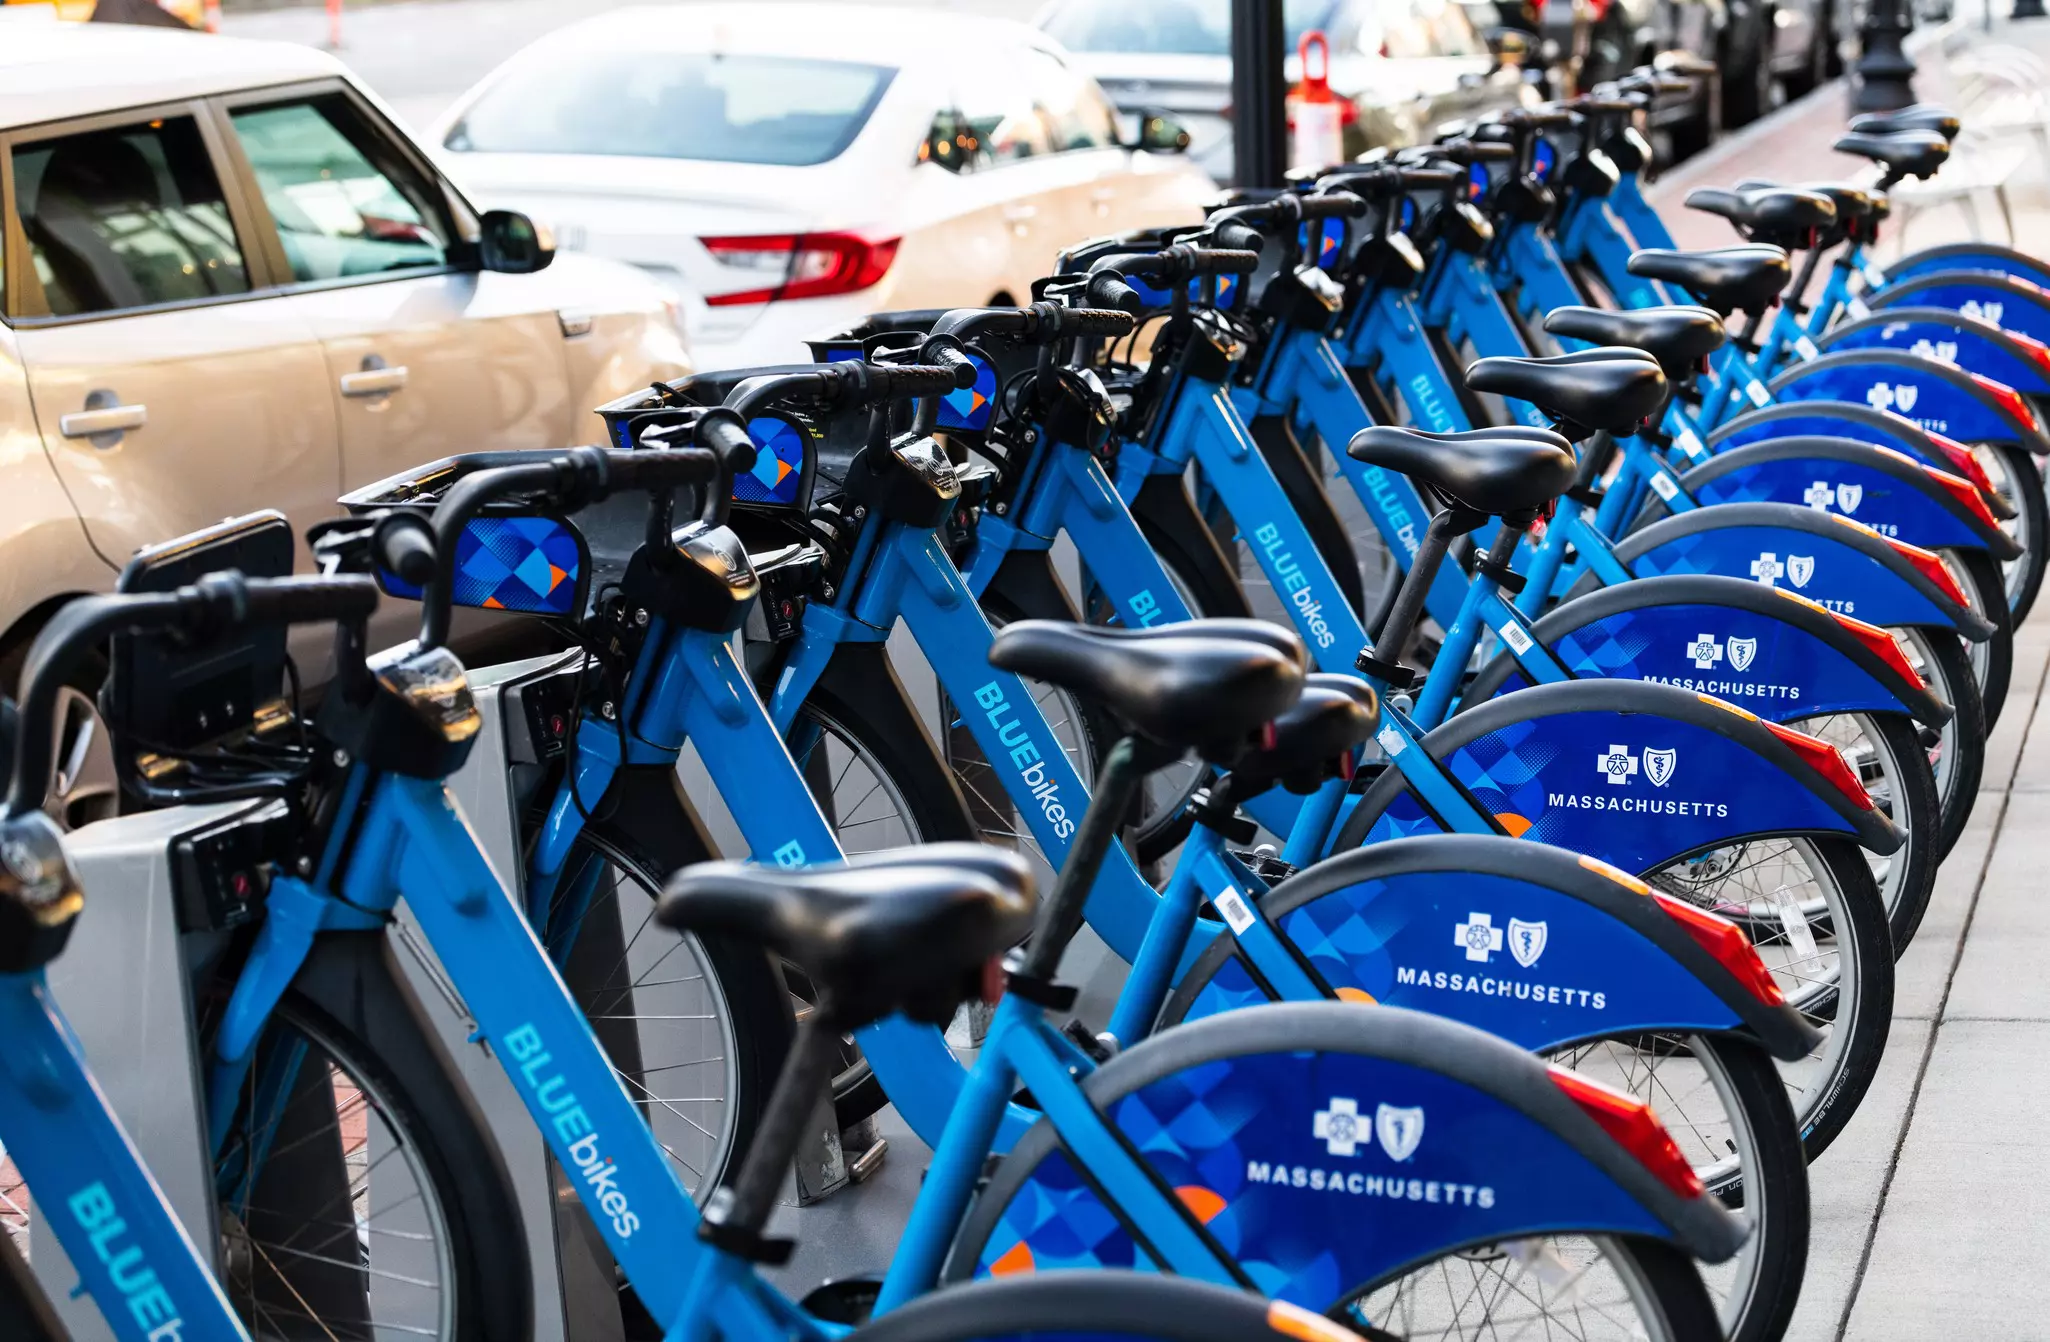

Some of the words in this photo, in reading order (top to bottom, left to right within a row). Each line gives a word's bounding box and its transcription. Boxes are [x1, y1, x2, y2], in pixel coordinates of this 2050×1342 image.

[1254, 521, 1335, 649] BLUEbikes
[973, 680, 1075, 840] BLUEbikes
[1548, 793, 1728, 818] MASSACHUSETTS
[1396, 966, 1606, 1009] MASSACHUSETTS
[502, 1022, 640, 1239] BLUEbikes
[1813, 1067, 1850, 1126] SCHWALBE
[1247, 1160, 1495, 1209] MASSACHUSETTS
[68, 1179, 186, 1342] BLUEb
